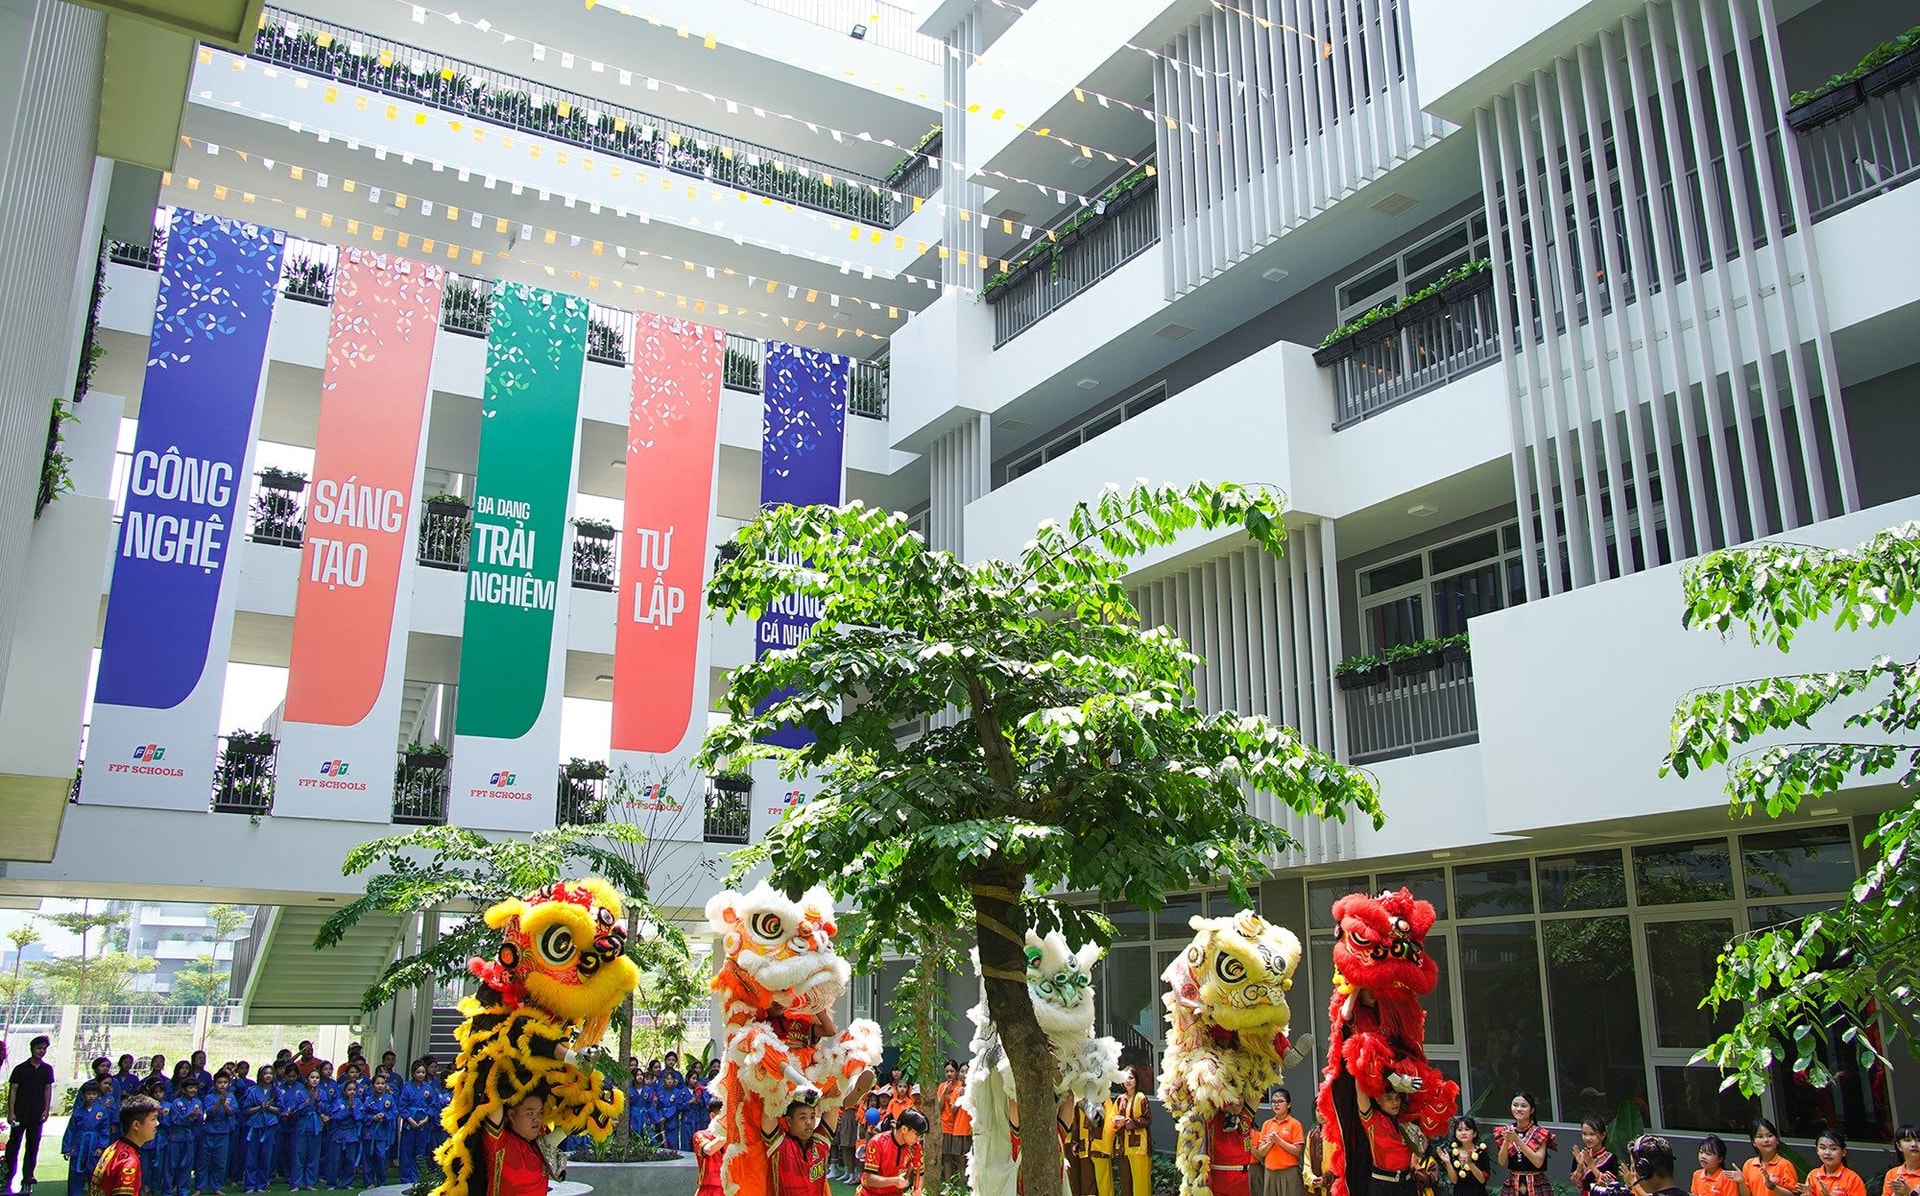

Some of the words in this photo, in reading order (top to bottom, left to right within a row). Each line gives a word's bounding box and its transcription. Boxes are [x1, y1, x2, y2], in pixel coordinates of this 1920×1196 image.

[131, 446, 233, 508] CÔNG
[313, 475, 404, 533] SÁNG
[477, 495, 495, 514] ĐA
[497, 499, 530, 519] DẠNG
[123, 511, 225, 574] NGHỆ
[475, 520, 536, 569] TRẢI
[637, 526, 674, 576] TỰ
[308, 537, 369, 590] TẠO
[469, 571, 556, 612] NGHIỆM
[633, 577, 685, 630] LẬP
[761, 619, 780, 644] CÁ
[783, 623, 820, 646] NHÂ
[133, 744, 166, 762] FPT
[108, 764, 130, 773] FPT
[131, 766, 184, 777] SCHOOLS
[320, 759, 349, 777] FPT
[490, 771, 516, 787] FPT
[298, 778, 318, 787] FPT
[319, 781, 366, 791] SCHOOLS
[470, 789, 488, 798] FPT
[489, 790, 533, 801] SCHOOLS
[768, 807, 782, 815] FPT
